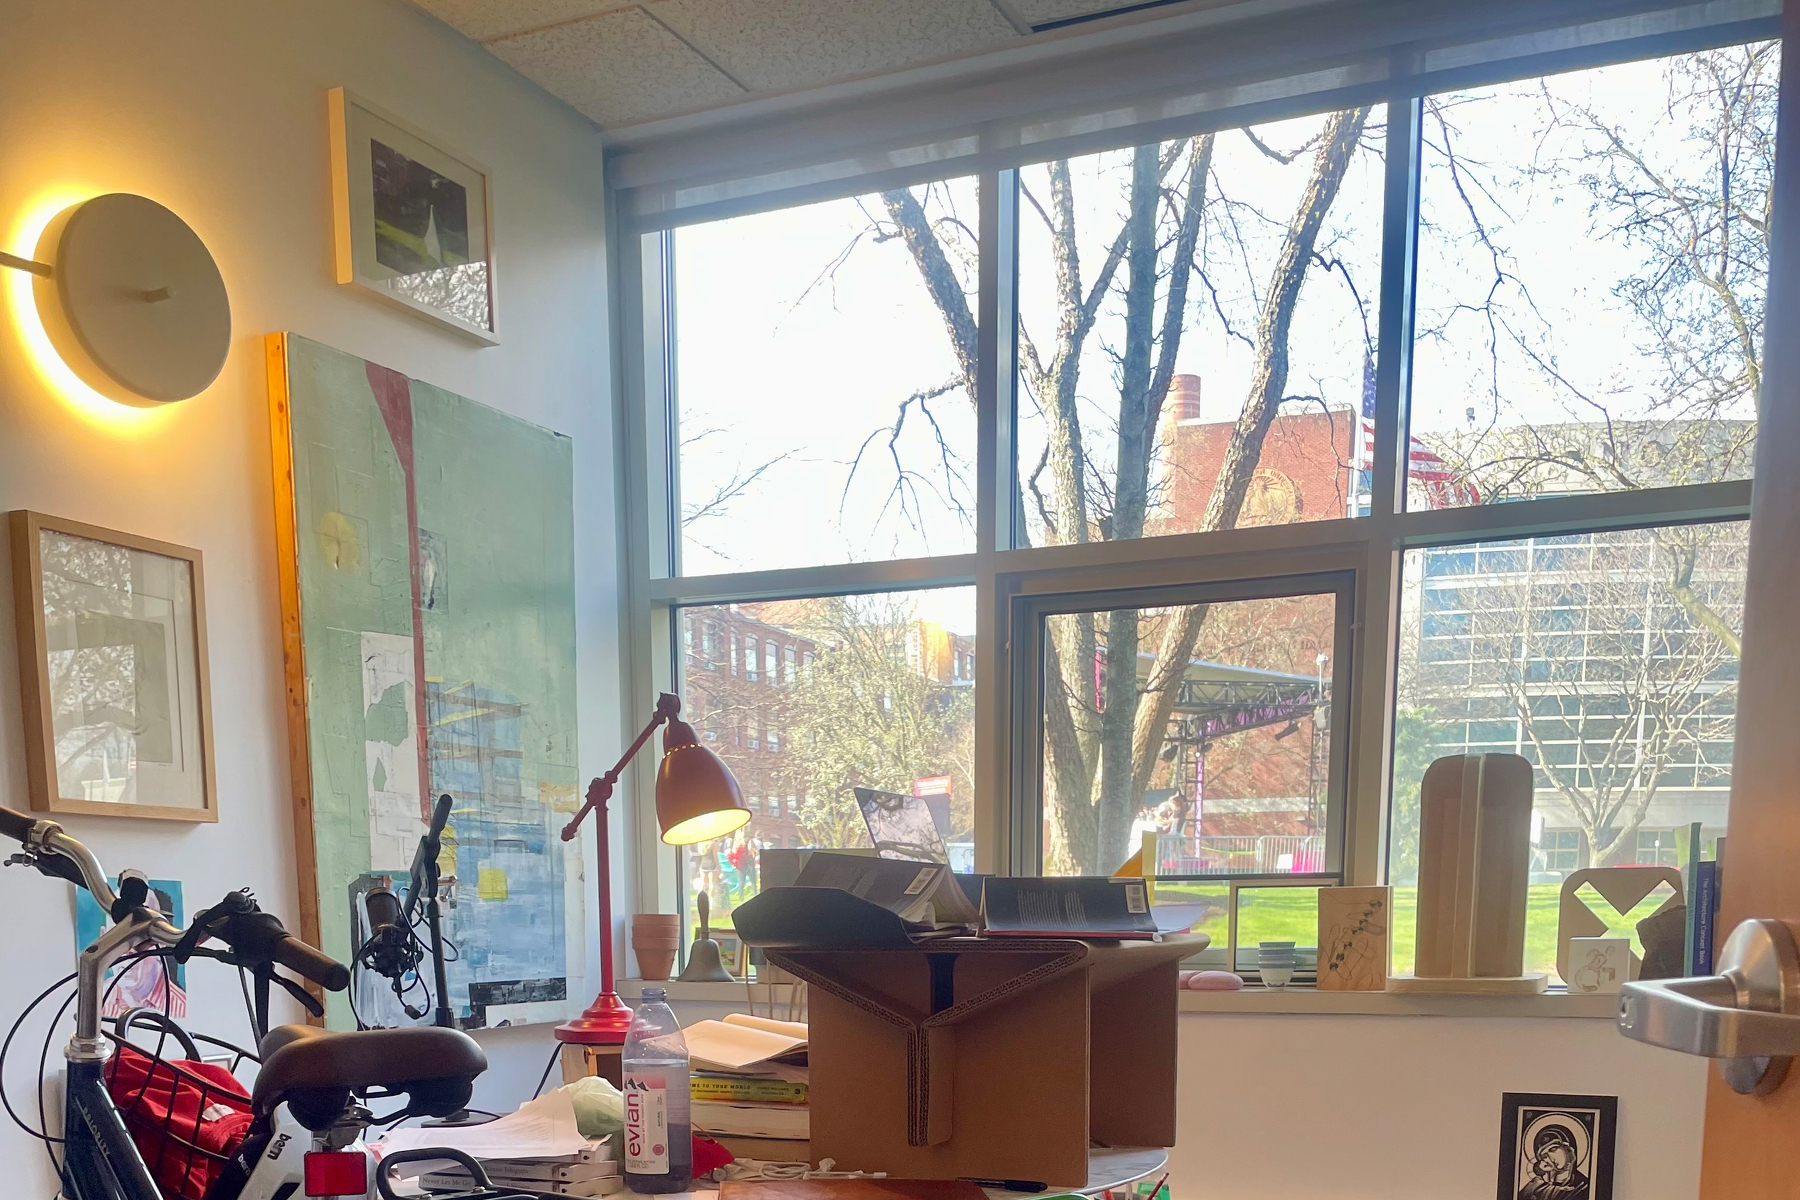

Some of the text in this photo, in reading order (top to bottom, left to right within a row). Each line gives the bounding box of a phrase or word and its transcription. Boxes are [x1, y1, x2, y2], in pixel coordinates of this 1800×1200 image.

[627, 1093, 641, 1157] evian
[267, 1133, 292, 1160] bern
[422, 1177, 440, 1185] Never
